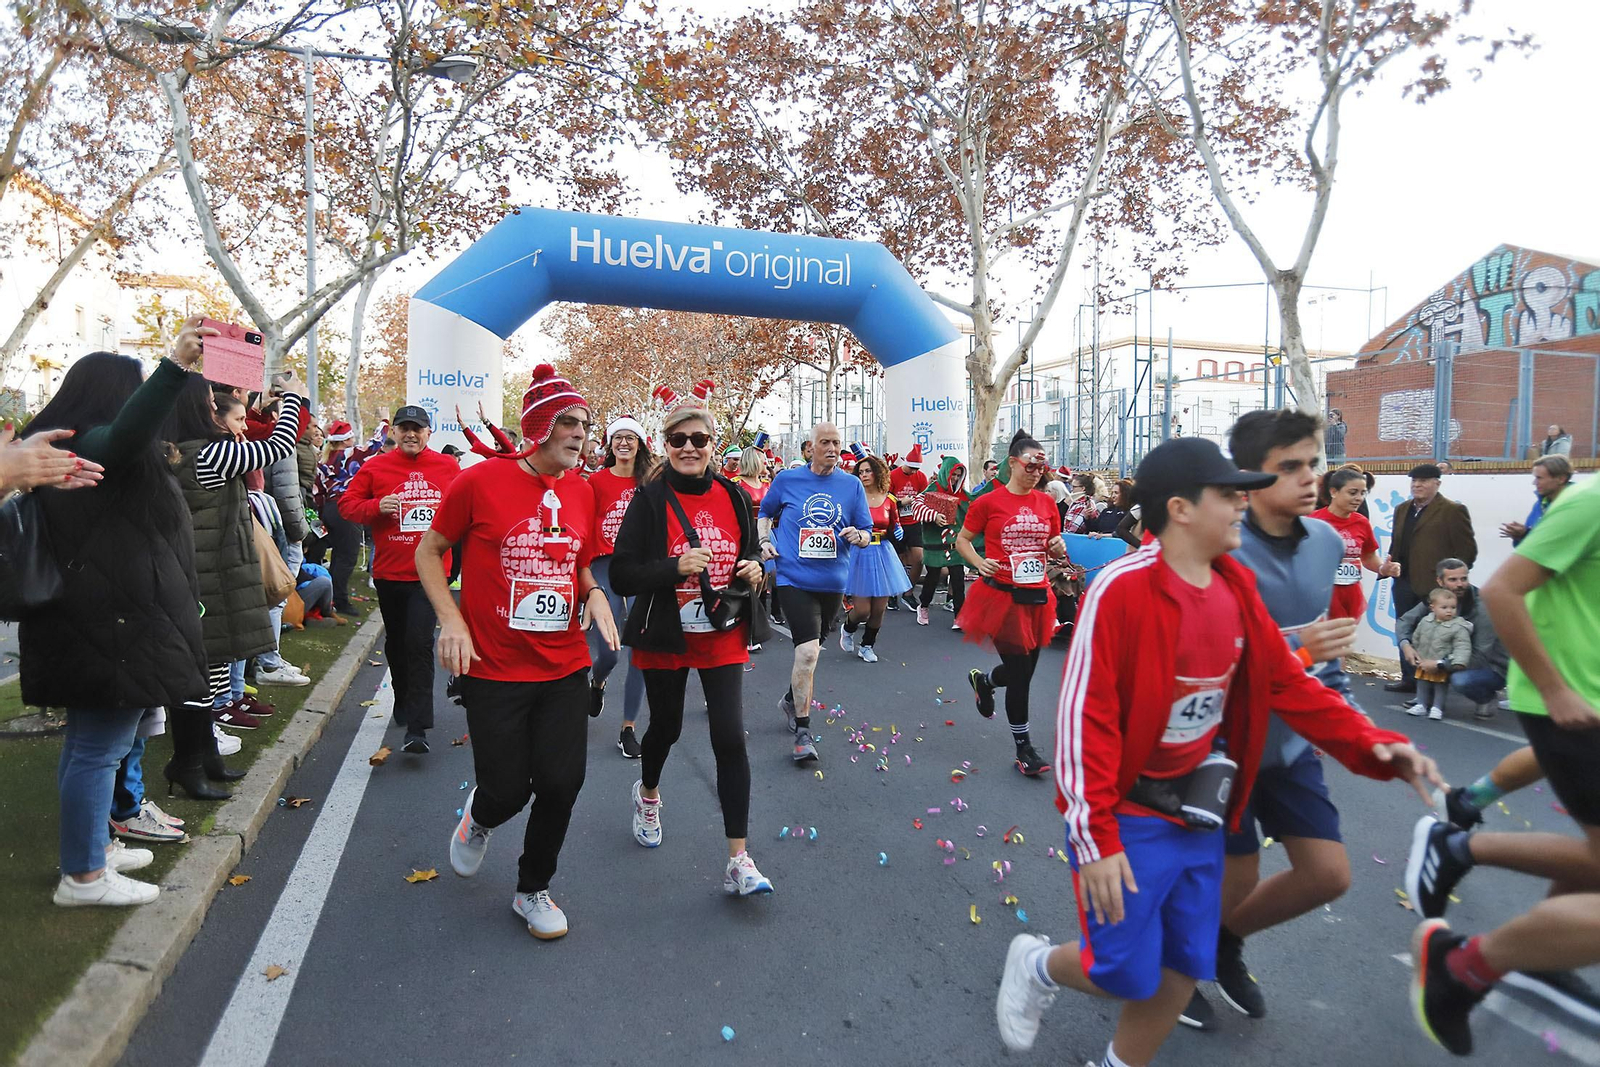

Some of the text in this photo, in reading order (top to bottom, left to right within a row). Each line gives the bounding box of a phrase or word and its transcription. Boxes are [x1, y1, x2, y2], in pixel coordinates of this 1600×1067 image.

[570, 227, 851, 290] Huelva original
[418, 369, 484, 389] Huelva
[911, 396, 963, 412] Huelva
[441, 423, 483, 433] HUEVA
[936, 443, 965, 451] HUELVA
[398, 489, 442, 500] ARRERA
[411, 509, 433, 521] 453
[1004, 522, 1050, 533] CARRERA
[673, 540, 736, 554] CARERA
[808, 536, 830, 549] 392
[501, 547, 529, 558] SAN
[1023, 561, 1039, 573] 335
[1338, 565, 1354, 576] 500
[1378, 579, 1388, 610] PORTUS
[535, 594, 557, 615] 59
[694, 602, 708, 618] 7
